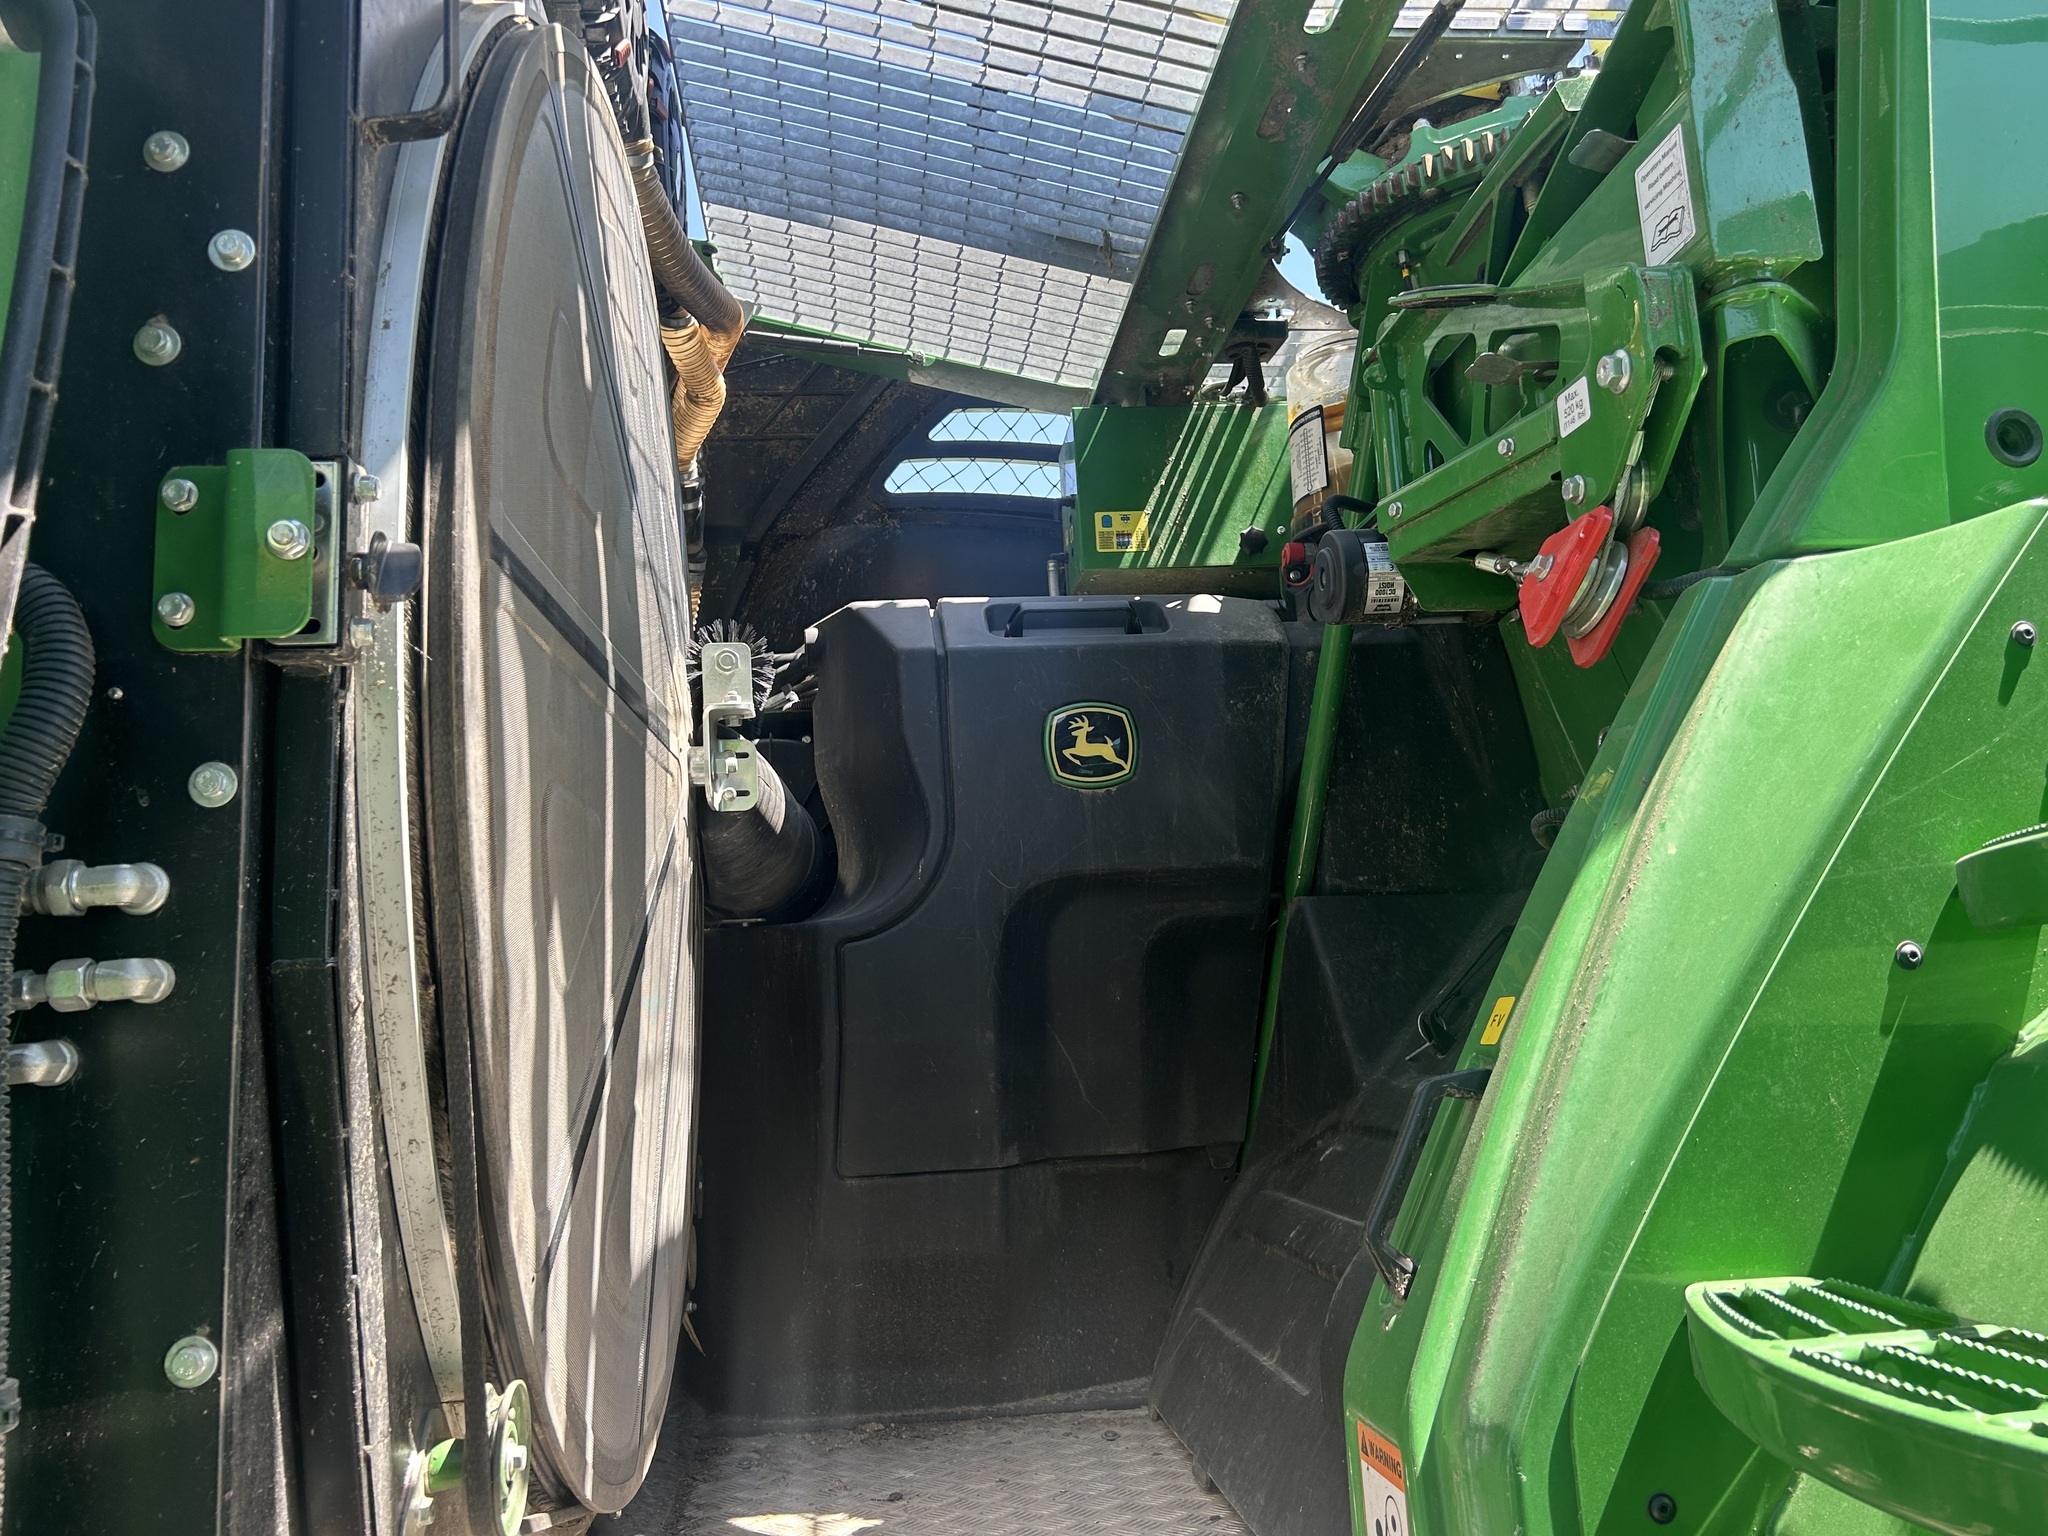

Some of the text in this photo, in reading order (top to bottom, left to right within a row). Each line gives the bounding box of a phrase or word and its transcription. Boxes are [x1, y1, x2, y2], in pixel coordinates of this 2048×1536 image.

[1661, 139, 1678, 161] Manual
[1564, 399, 1584, 419] 520 kg
[1489, 1013, 1506, 1028] FV
[1367, 1438, 1403, 1480] WARNING
